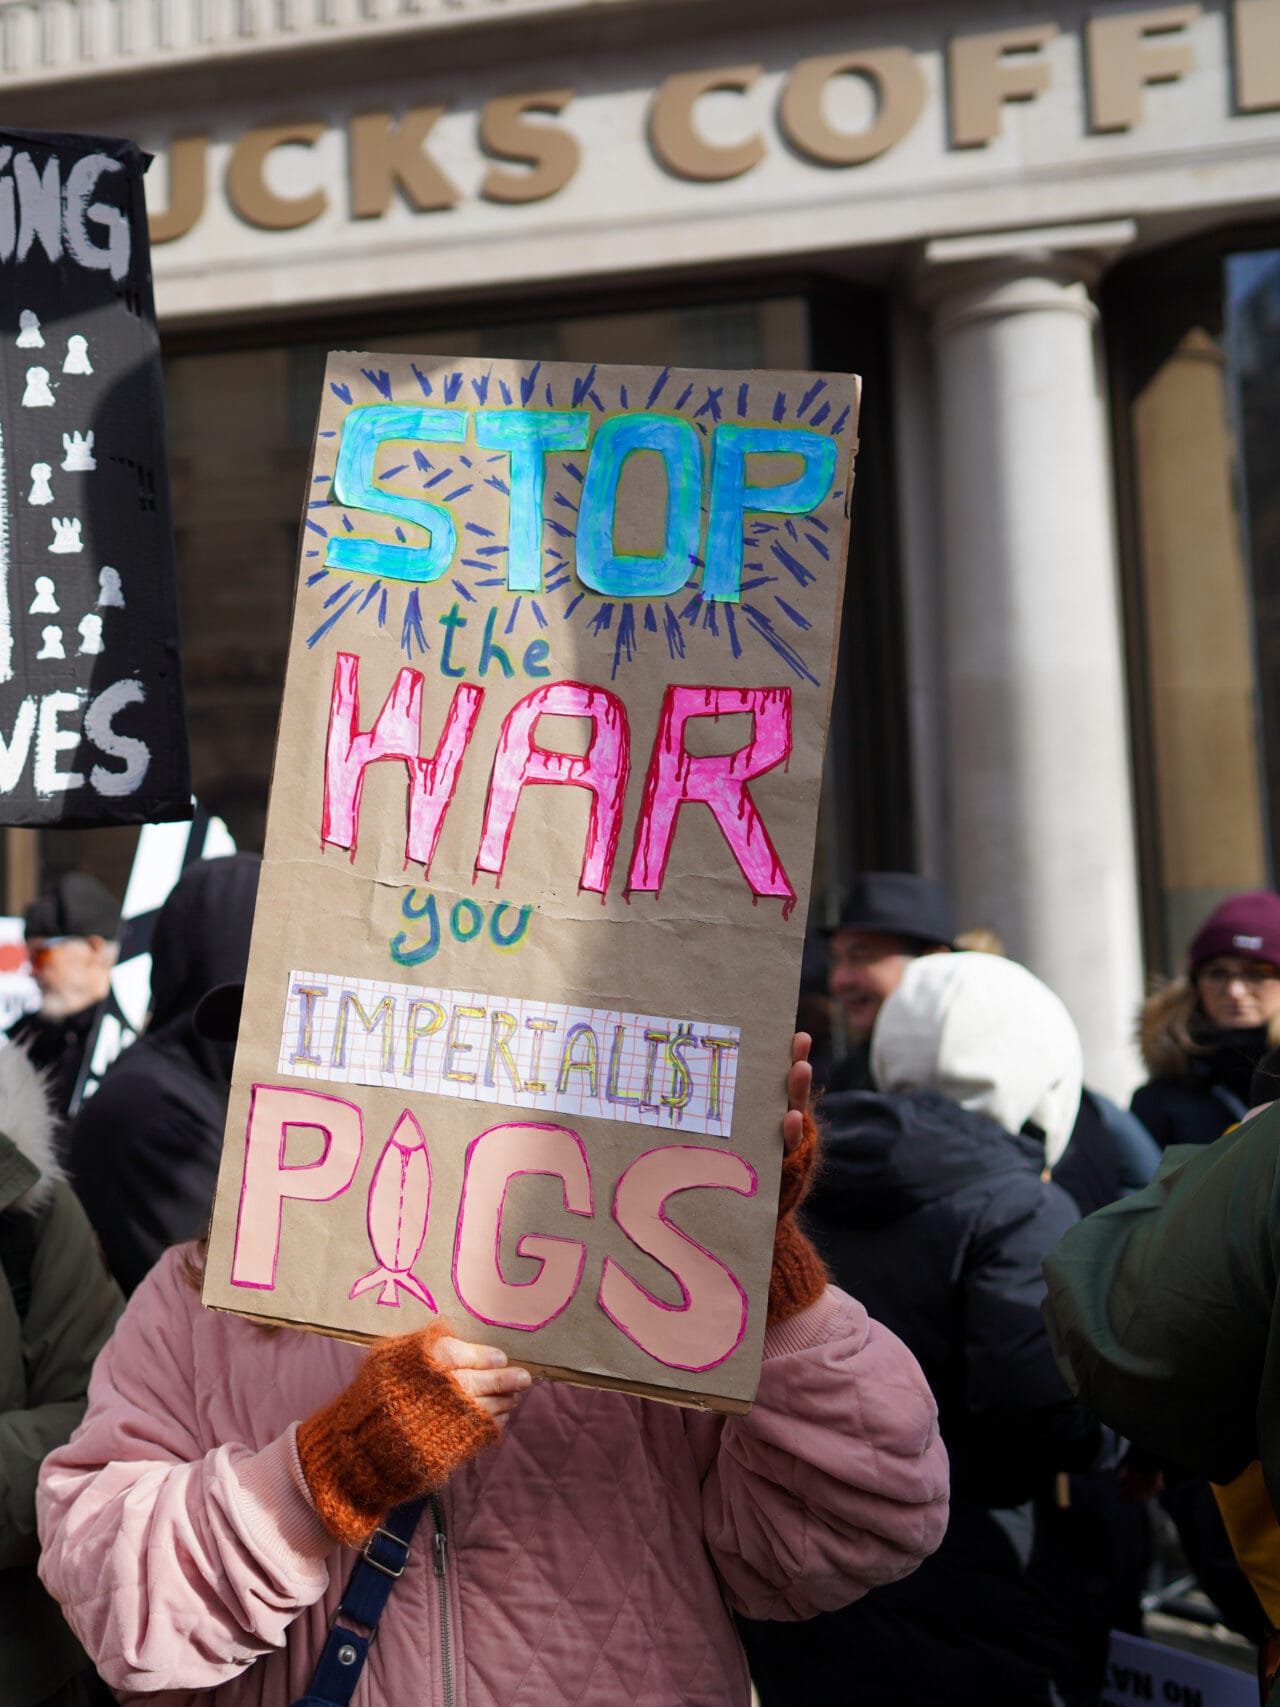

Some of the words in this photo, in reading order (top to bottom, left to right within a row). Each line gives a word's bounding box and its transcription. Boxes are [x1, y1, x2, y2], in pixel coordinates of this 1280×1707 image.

[323, 402, 838, 603] STOP
[438, 606, 552, 679] the
[320, 651, 797, 915] WAR
[389, 887, 534, 967] you
[230, 1083, 759, 1373] PIGS
